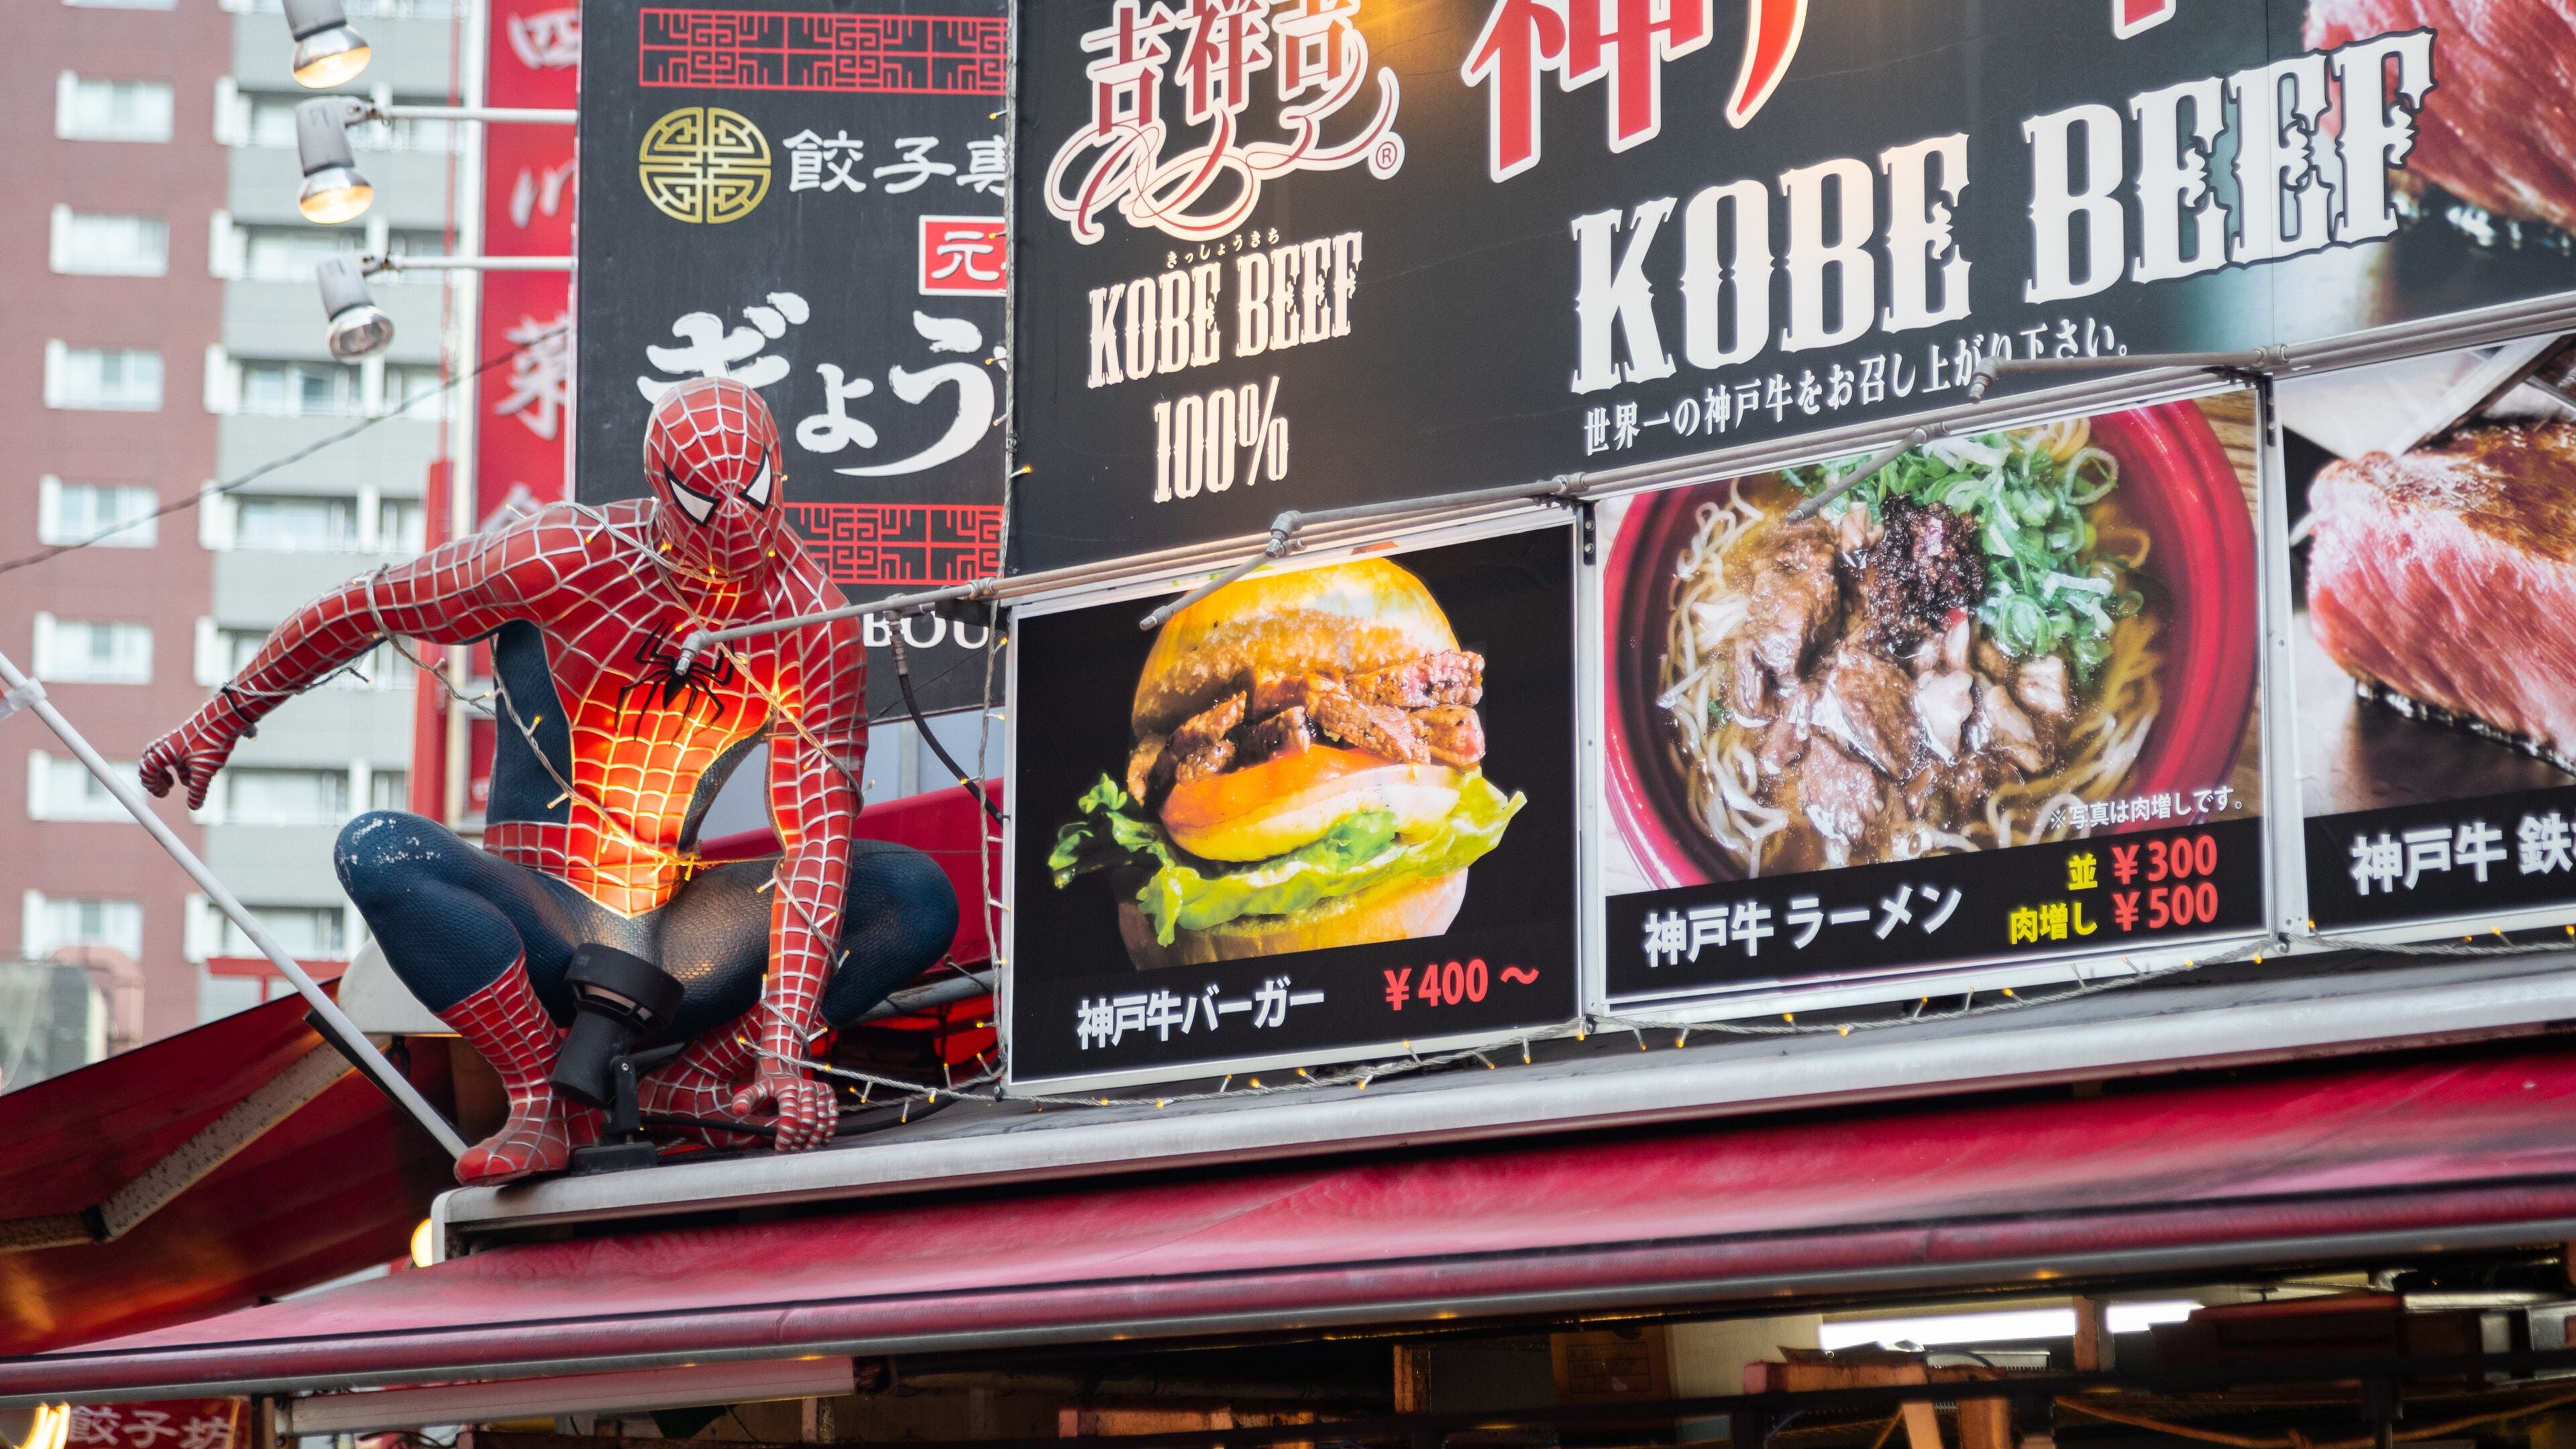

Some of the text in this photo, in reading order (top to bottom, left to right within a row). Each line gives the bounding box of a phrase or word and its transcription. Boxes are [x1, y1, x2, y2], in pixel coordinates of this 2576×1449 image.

[1167, 227, 1280, 269] きっしょうきち
[1571, 132, 1972, 395] KOBE
[2022, 27, 2439, 305] BEEF
[1087, 230, 1363, 389] KOBE BEEF
[1153, 375, 1289, 504] 100%
[2068, 853, 2098, 891] 並
[2010, 902, 2098, 945] 肉増し
[1077, 975, 1325, 1051] 神戸牛バーガー
